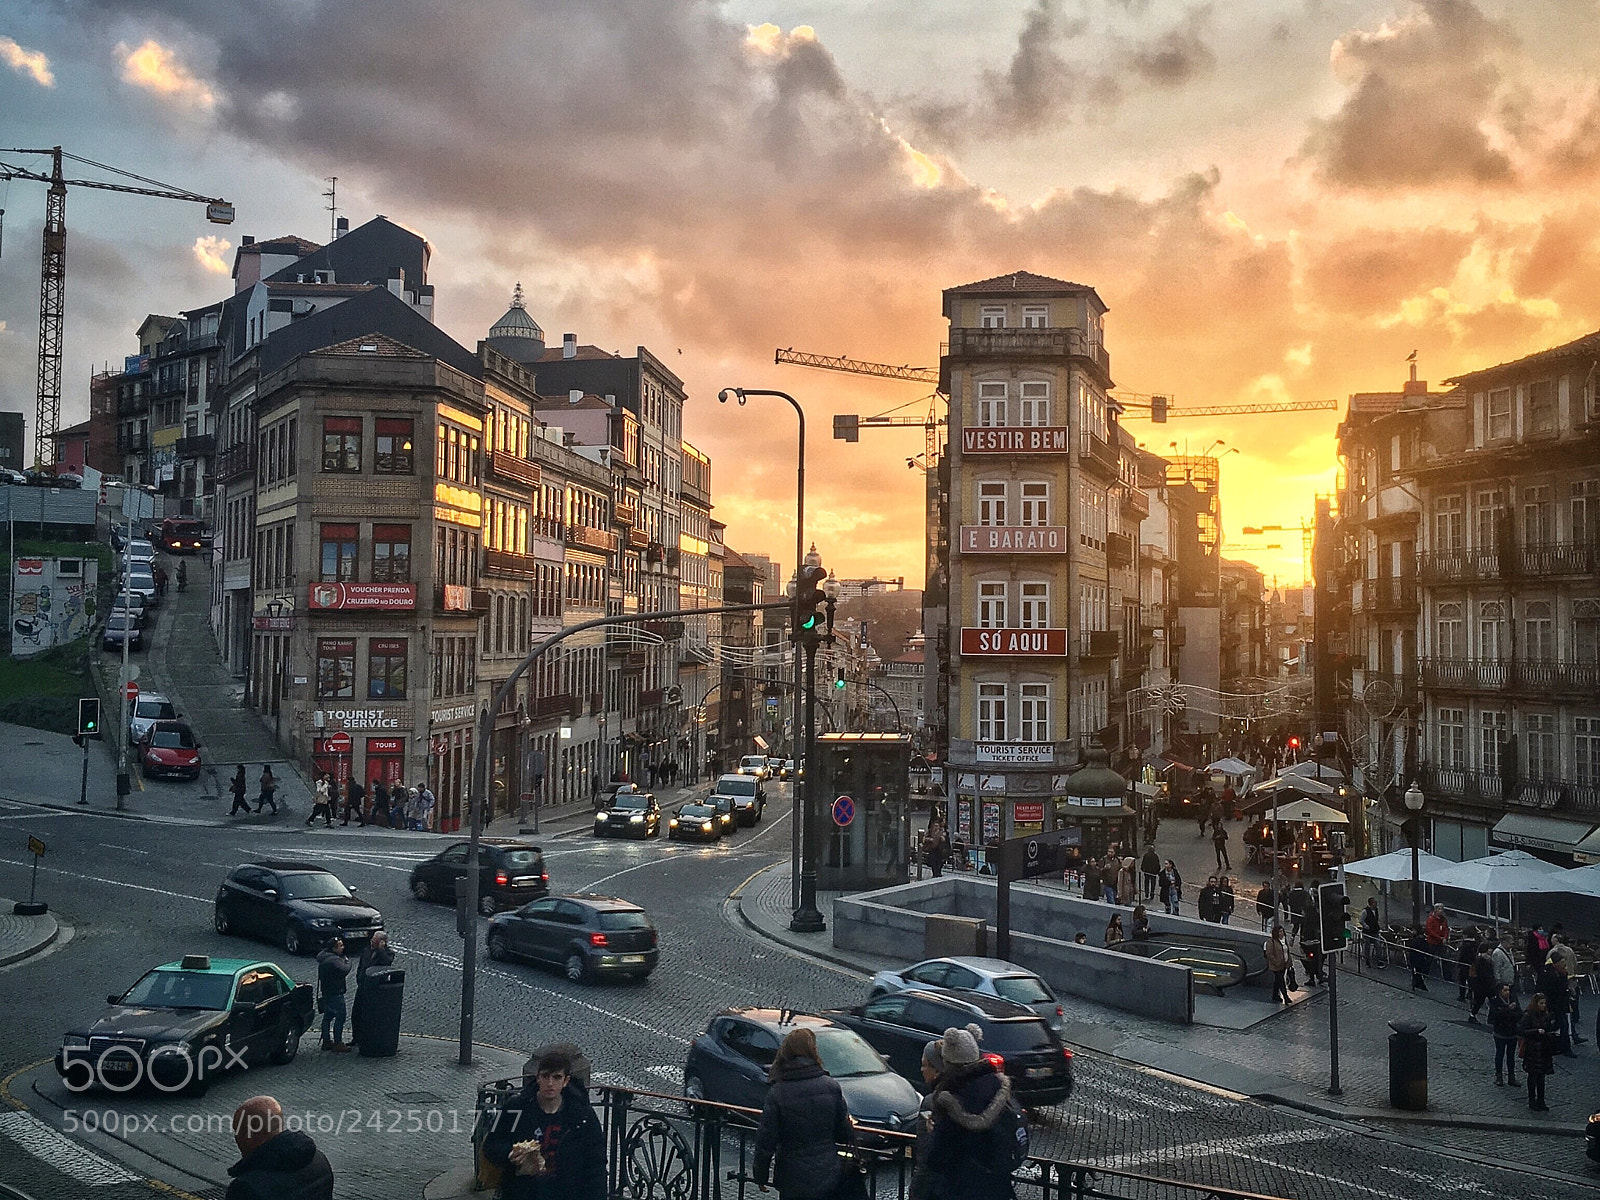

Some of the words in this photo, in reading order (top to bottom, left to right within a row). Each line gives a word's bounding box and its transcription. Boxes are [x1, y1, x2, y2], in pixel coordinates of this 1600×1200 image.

[965, 431, 1024, 449] VESTIR
[1031, 431, 1065, 449] BEM
[970, 530, 978, 548] E
[989, 530, 1057, 548] BARATO
[980, 630, 1002, 651] SÓ
[1008, 633, 1048, 651] AQUI
[327, 710, 384, 719] TOURIST
[431, 708, 455, 722] TOURIST
[454, 704, 475, 719] SERVICE
[343, 719, 398, 728] SERVICE
[980, 746, 1015, 754] TOURIST
[1018, 746, 1051, 754] SERVICE
